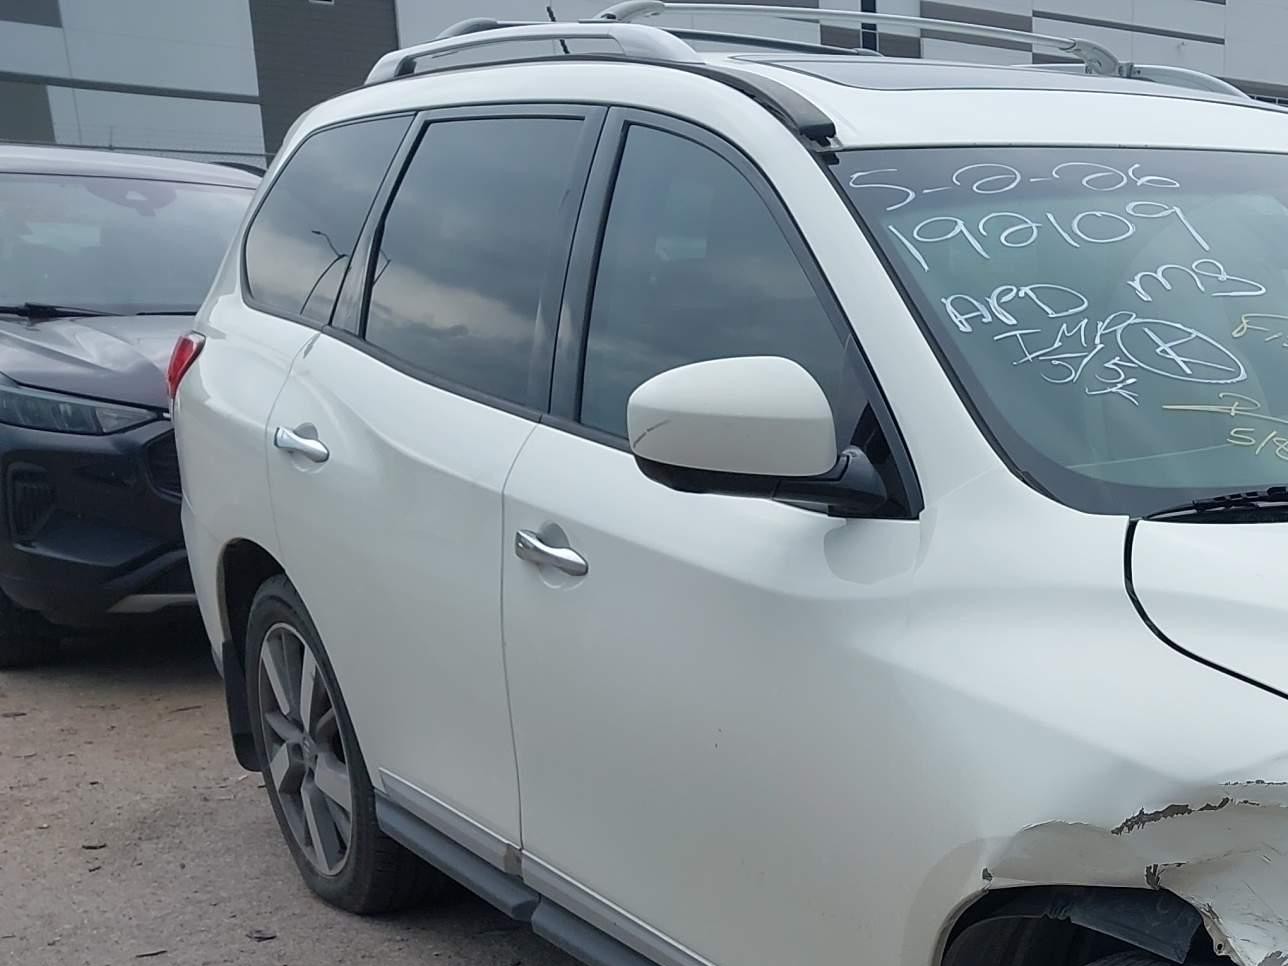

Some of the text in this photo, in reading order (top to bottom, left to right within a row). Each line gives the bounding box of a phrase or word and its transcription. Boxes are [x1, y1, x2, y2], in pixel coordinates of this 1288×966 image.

[850, 162, 1180, 211] 5-2-26
[888, 200, 1210, 272] 192109
[940, 284, 1089, 333] APD
